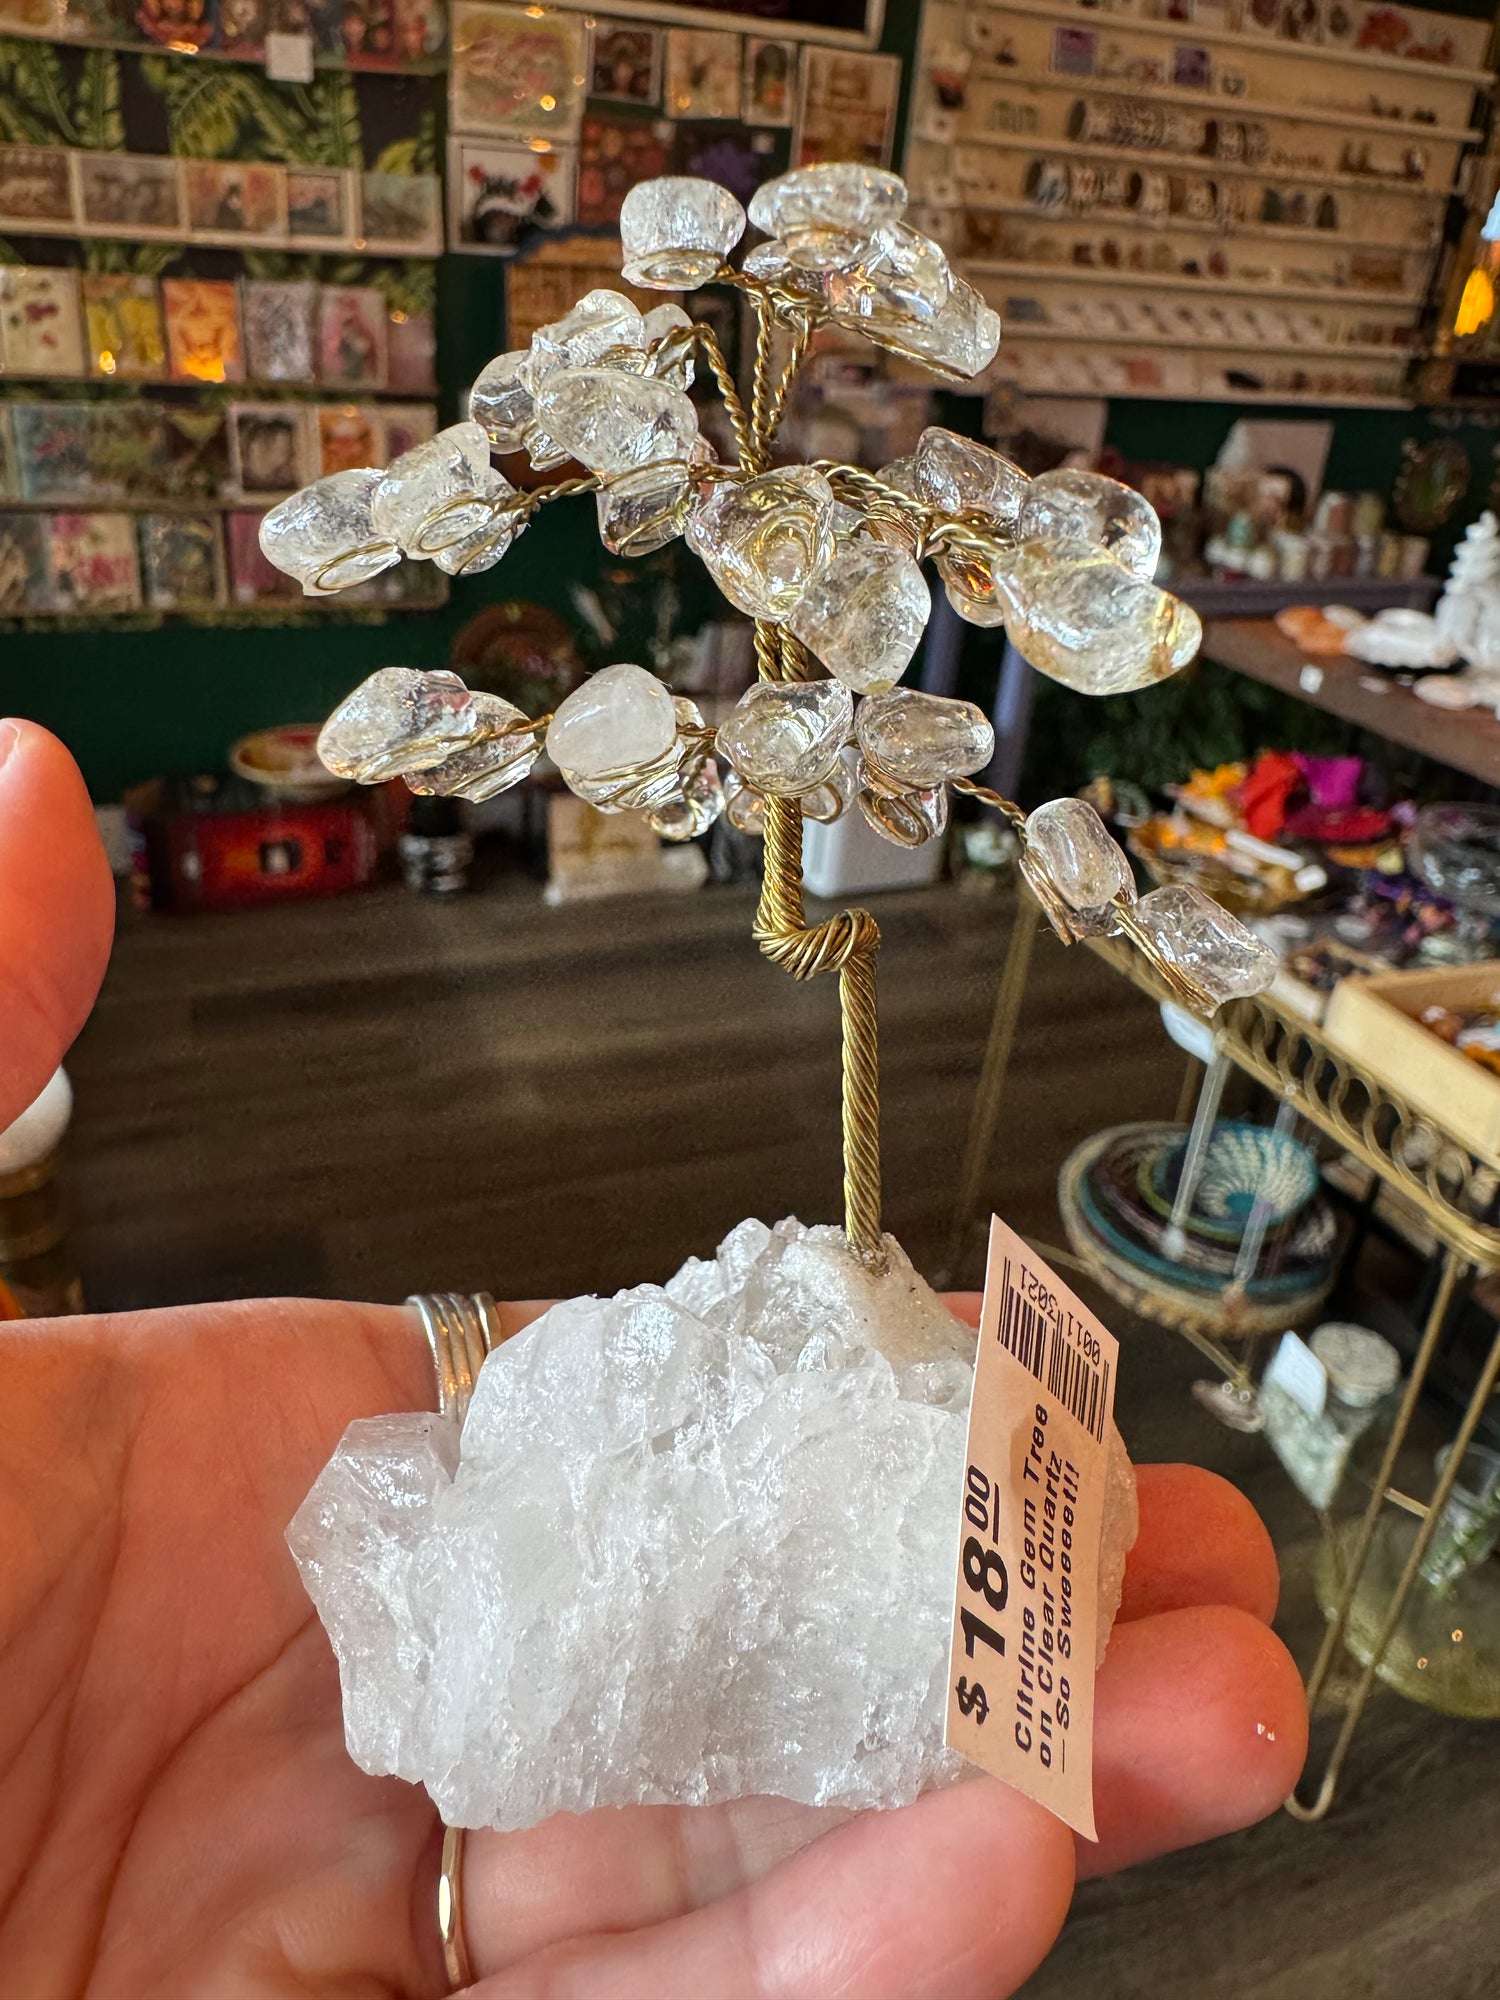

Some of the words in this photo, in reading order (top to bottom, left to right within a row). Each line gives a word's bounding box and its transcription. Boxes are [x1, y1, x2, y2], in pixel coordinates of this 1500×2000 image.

[1021, 1264, 1058, 1323] 3021
[1067, 1311, 1101, 1366] 0011
[1023, 1403, 1048, 1484] Tree
[1020, 1498, 1036, 1590] Gem
[1039, 1450, 1062, 1573] Quartz
[1057, 1461, 1080, 1660] Sweeeet!!
[1015, 1606, 1035, 1753] Citrine
[1038, 1582, 1055, 1694] Clear
[1040, 1710, 1053, 1768] on
